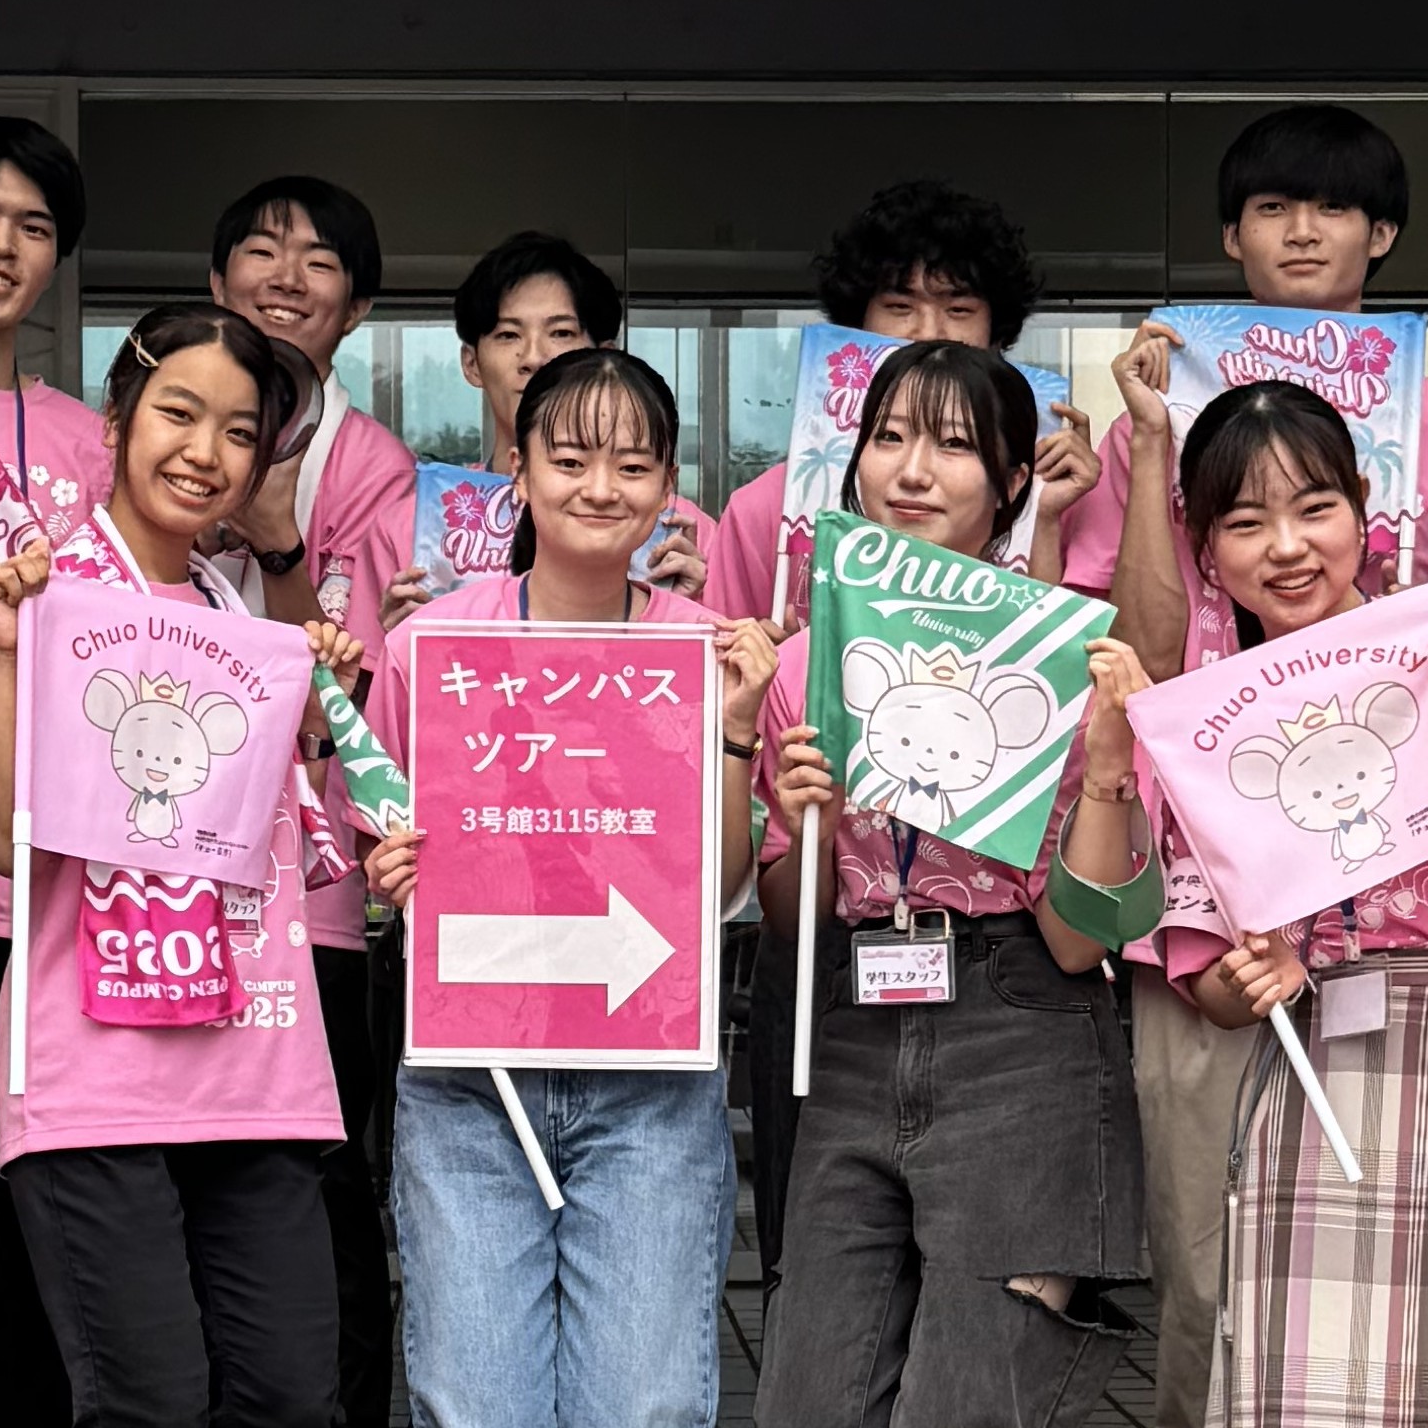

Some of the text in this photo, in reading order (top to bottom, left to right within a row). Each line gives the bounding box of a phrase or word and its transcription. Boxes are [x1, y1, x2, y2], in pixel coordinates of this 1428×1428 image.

[833, 524, 1007, 608] Chuo
[910, 609, 987, 650] University
[72, 616, 272, 704] Chuo University
[440, 661, 682, 707] キャンパス
[1193, 644, 1428, 753] Chuo University
[464, 731, 607, 773] ツアー
[460, 806, 658, 835] 3号館3115教室
